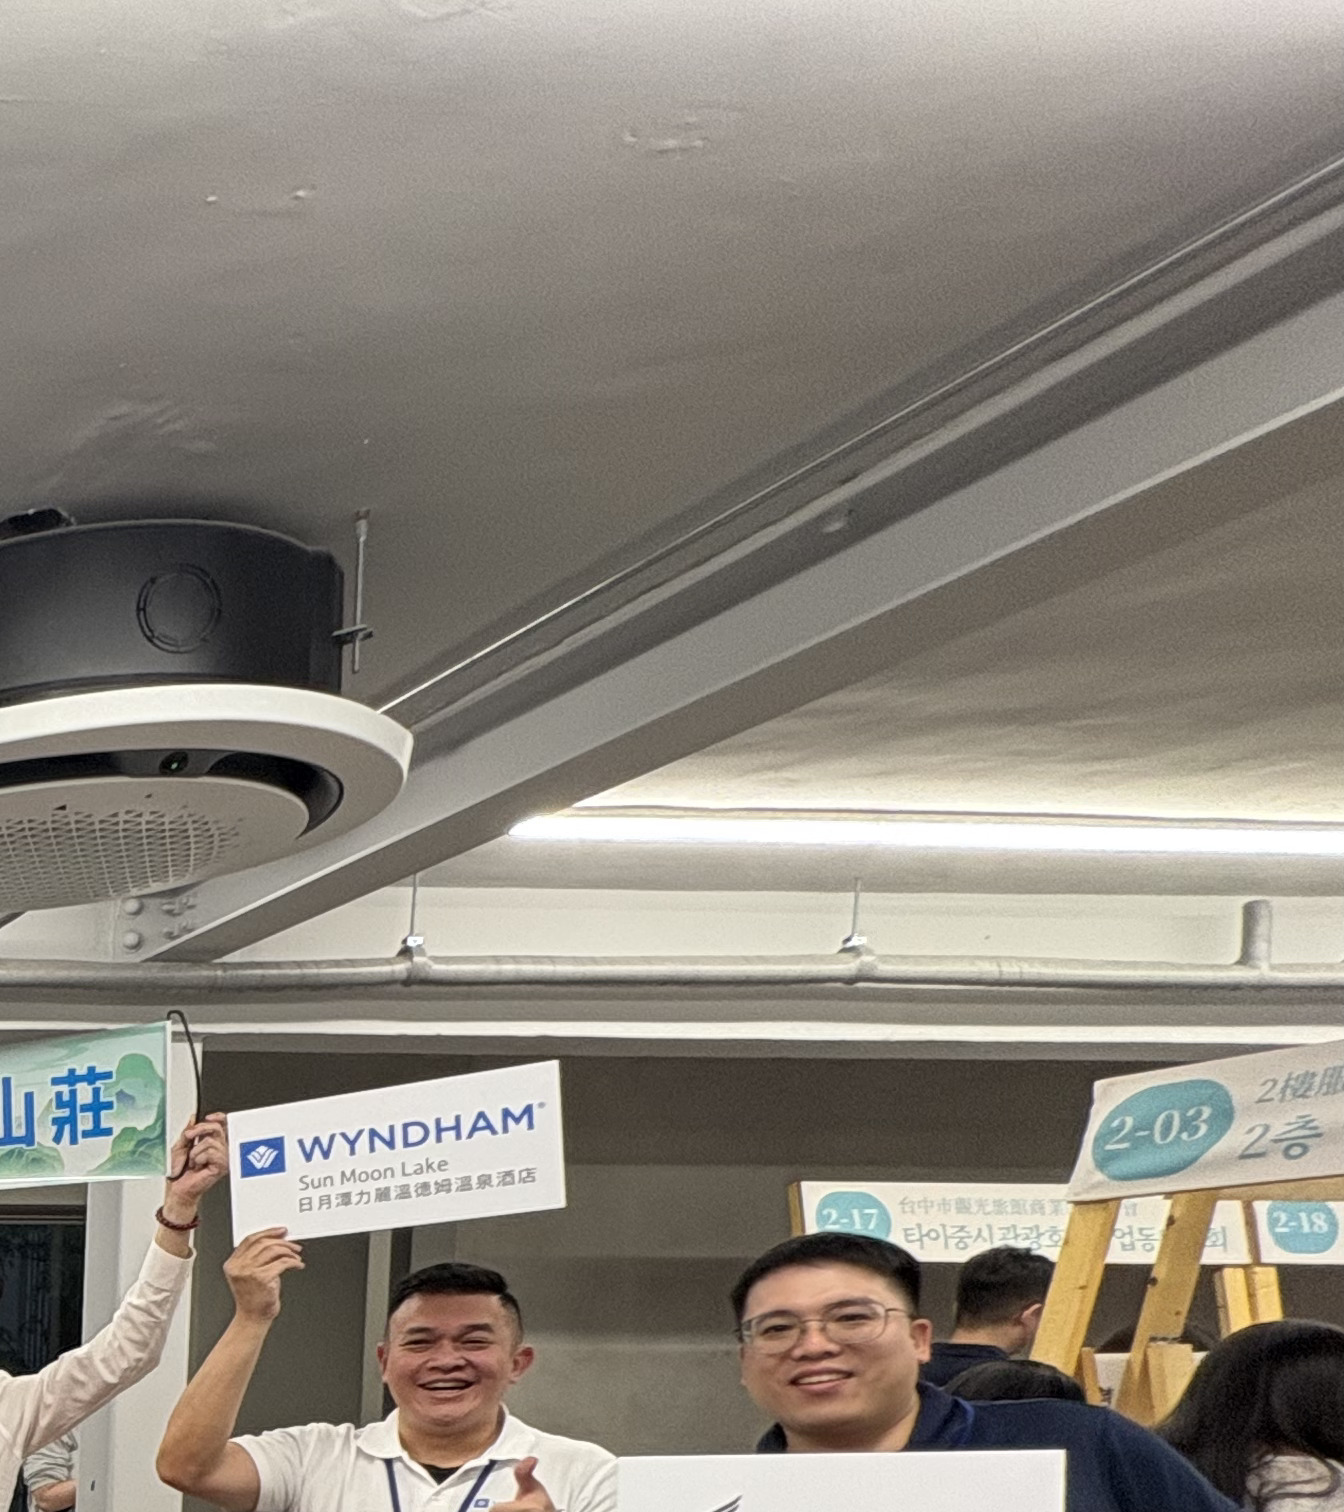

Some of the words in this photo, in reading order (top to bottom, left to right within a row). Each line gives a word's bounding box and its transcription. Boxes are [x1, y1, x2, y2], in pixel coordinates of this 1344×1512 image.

[297, 1103, 535, 1163] WYNDHAM
[1104, 1105, 1214, 1153] 2-03
[1238, 1113, 1324, 1160] 2층
[298, 1174, 334, 1191] Sun
[340, 1167, 395, 1186] Moon
[401, 1157, 449, 1177] Lake
[822, 1208, 879, 1230] 2-17
[1272, 1211, 1329, 1233] 2-18
